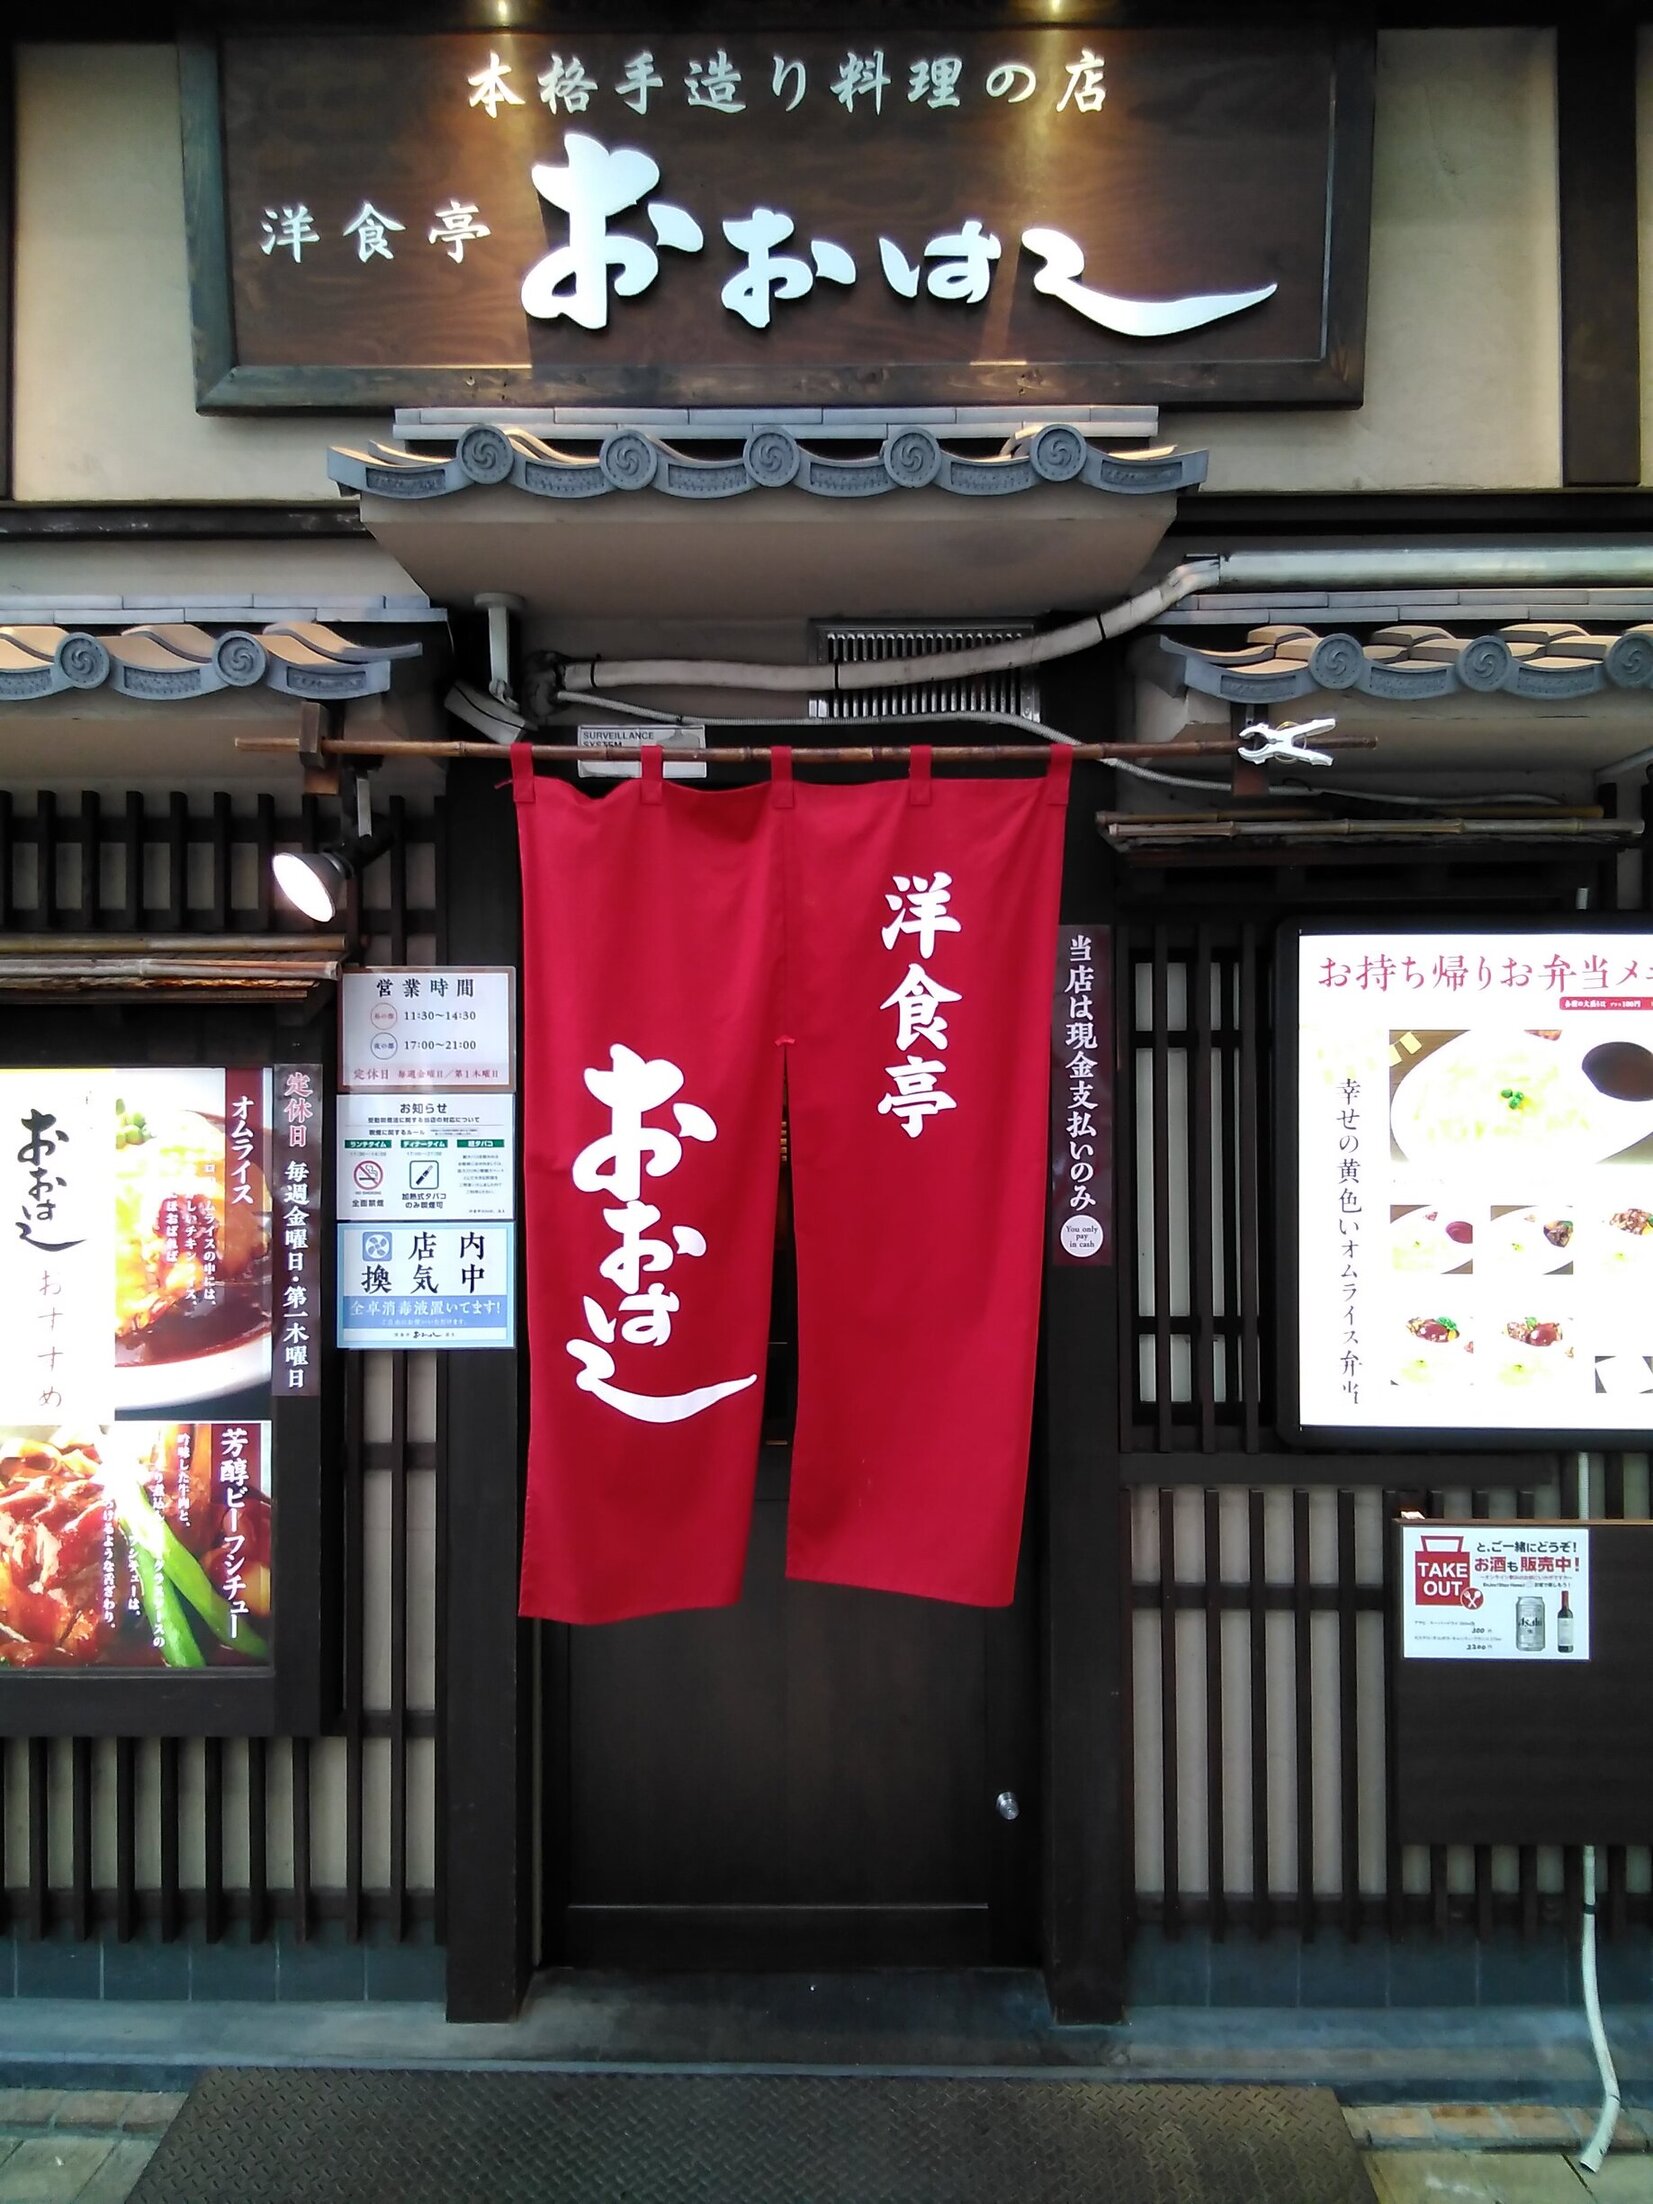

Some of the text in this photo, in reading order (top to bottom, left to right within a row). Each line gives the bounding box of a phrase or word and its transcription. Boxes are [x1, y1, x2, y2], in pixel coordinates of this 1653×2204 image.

[467, 49, 1108, 118] 本格手造り料理の店
[258, 200, 492, 263] 洋食亭
[583, 731, 654, 740] SURVEILLANCE
[376, 978, 475, 999] 営業時間
[878, 870, 963, 1139] 洋食亭
[353, 1069, 390, 1081] 定休日
[1064, 934, 1099, 1212] 当店は現金支払いのみ
[399, 1102, 448, 1114] お知らせ
[231, 1095, 255, 1205] オムライス
[350, 1140, 387, 1148] ランチタイム
[403, 1140, 446, 1148] ディナータイム
[352, 1199, 385, 1208] 全面禁煙
[282, 1072, 313, 1389] 定休日 毎週金曜日・第一木曜日
[1066, 1225, 1099, 1235] You only
[408, 1231, 485, 1262] 店内
[1069, 1240, 1095, 1248] in cash
[361, 1263, 486, 1295] 換気中
[220, 1427, 250, 1639] 芳醇ビーフシチュー
[1417, 1562, 1469, 1578] TAKE
[1423, 1580, 1463, 1597] OUT
